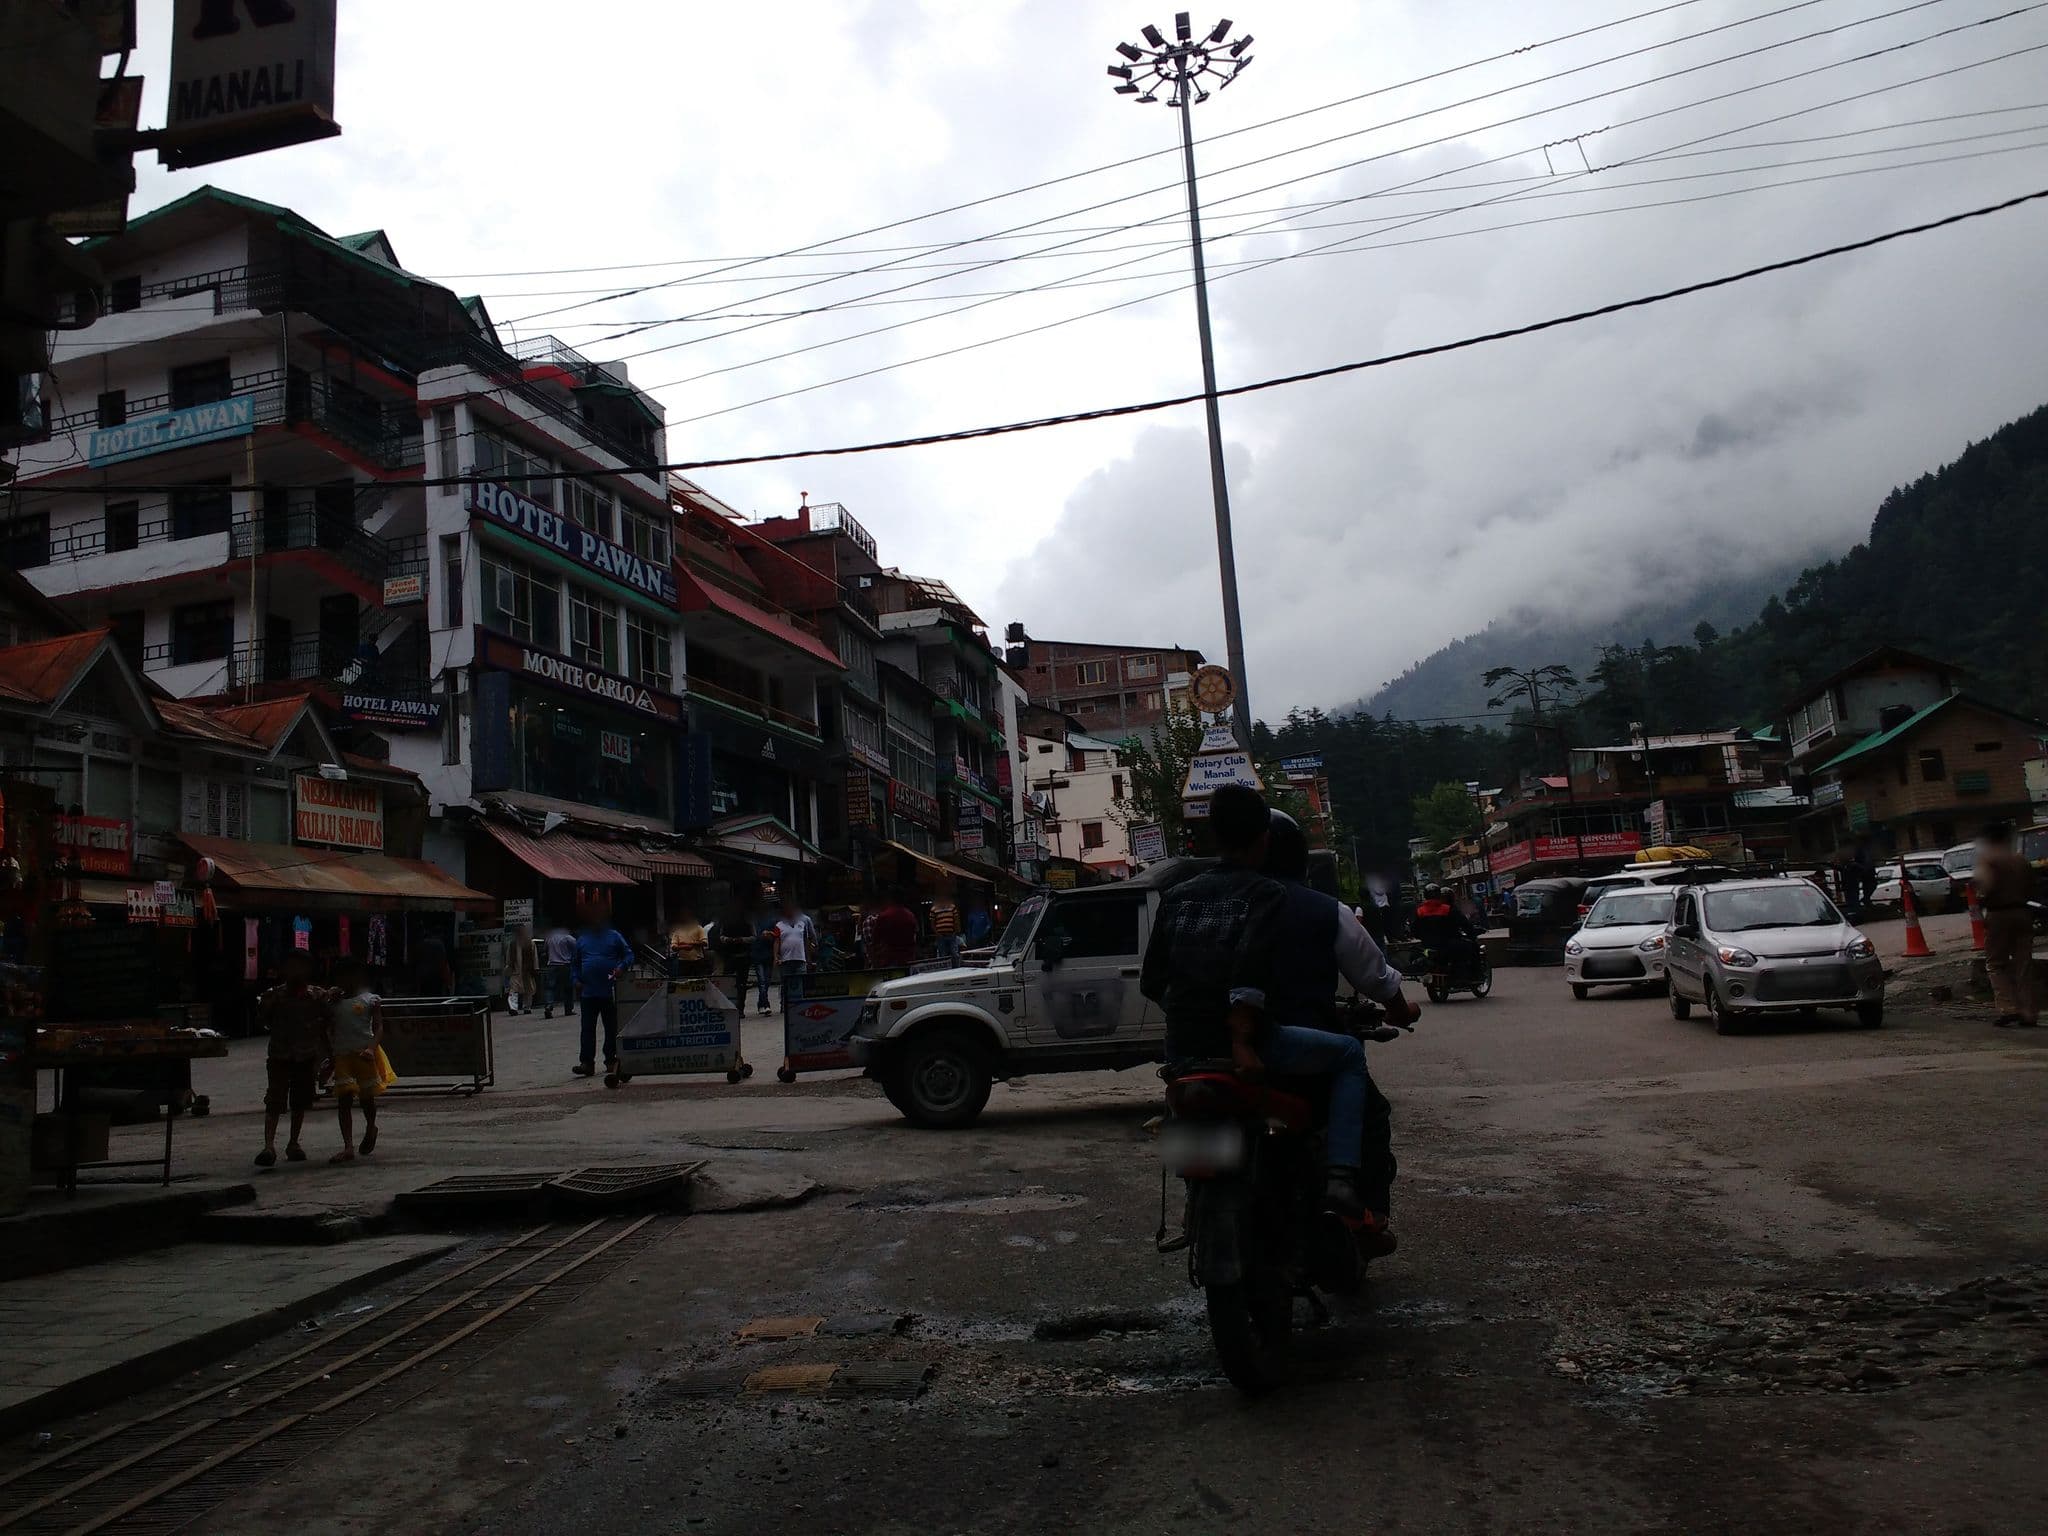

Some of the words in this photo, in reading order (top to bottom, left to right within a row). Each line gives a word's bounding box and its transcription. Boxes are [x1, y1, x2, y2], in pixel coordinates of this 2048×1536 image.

[176, 59, 305, 121] MANALI
[96, 423, 163, 455] HOTEL
[168, 400, 249, 440] PAWAN
[476, 481, 570, 551] HOTEL
[578, 530, 663, 598] PAWAN
[522, 648, 584, 689] MONTE
[585, 672, 635, 705] CARLO
[343, 695, 388, 711] HOTEL
[390, 700, 441, 716] PAWAN
[364, 714, 427, 726] RECEPTION
[603, 732, 627, 758] SALE
[1193, 759, 1223, 770] Rotary
[1224, 756, 1246, 767] Club
[1204, 768, 1235, 779] Manali
[301, 776, 377, 814] NEELKANTH
[296, 811, 336, 842] KULLU
[339, 815, 383, 848] SHAWLS
[1550, 837, 1569, 845] HIM
[680, 1012, 726, 1025] HOMES
[680, 1024, 726, 1034] DELIVERED
